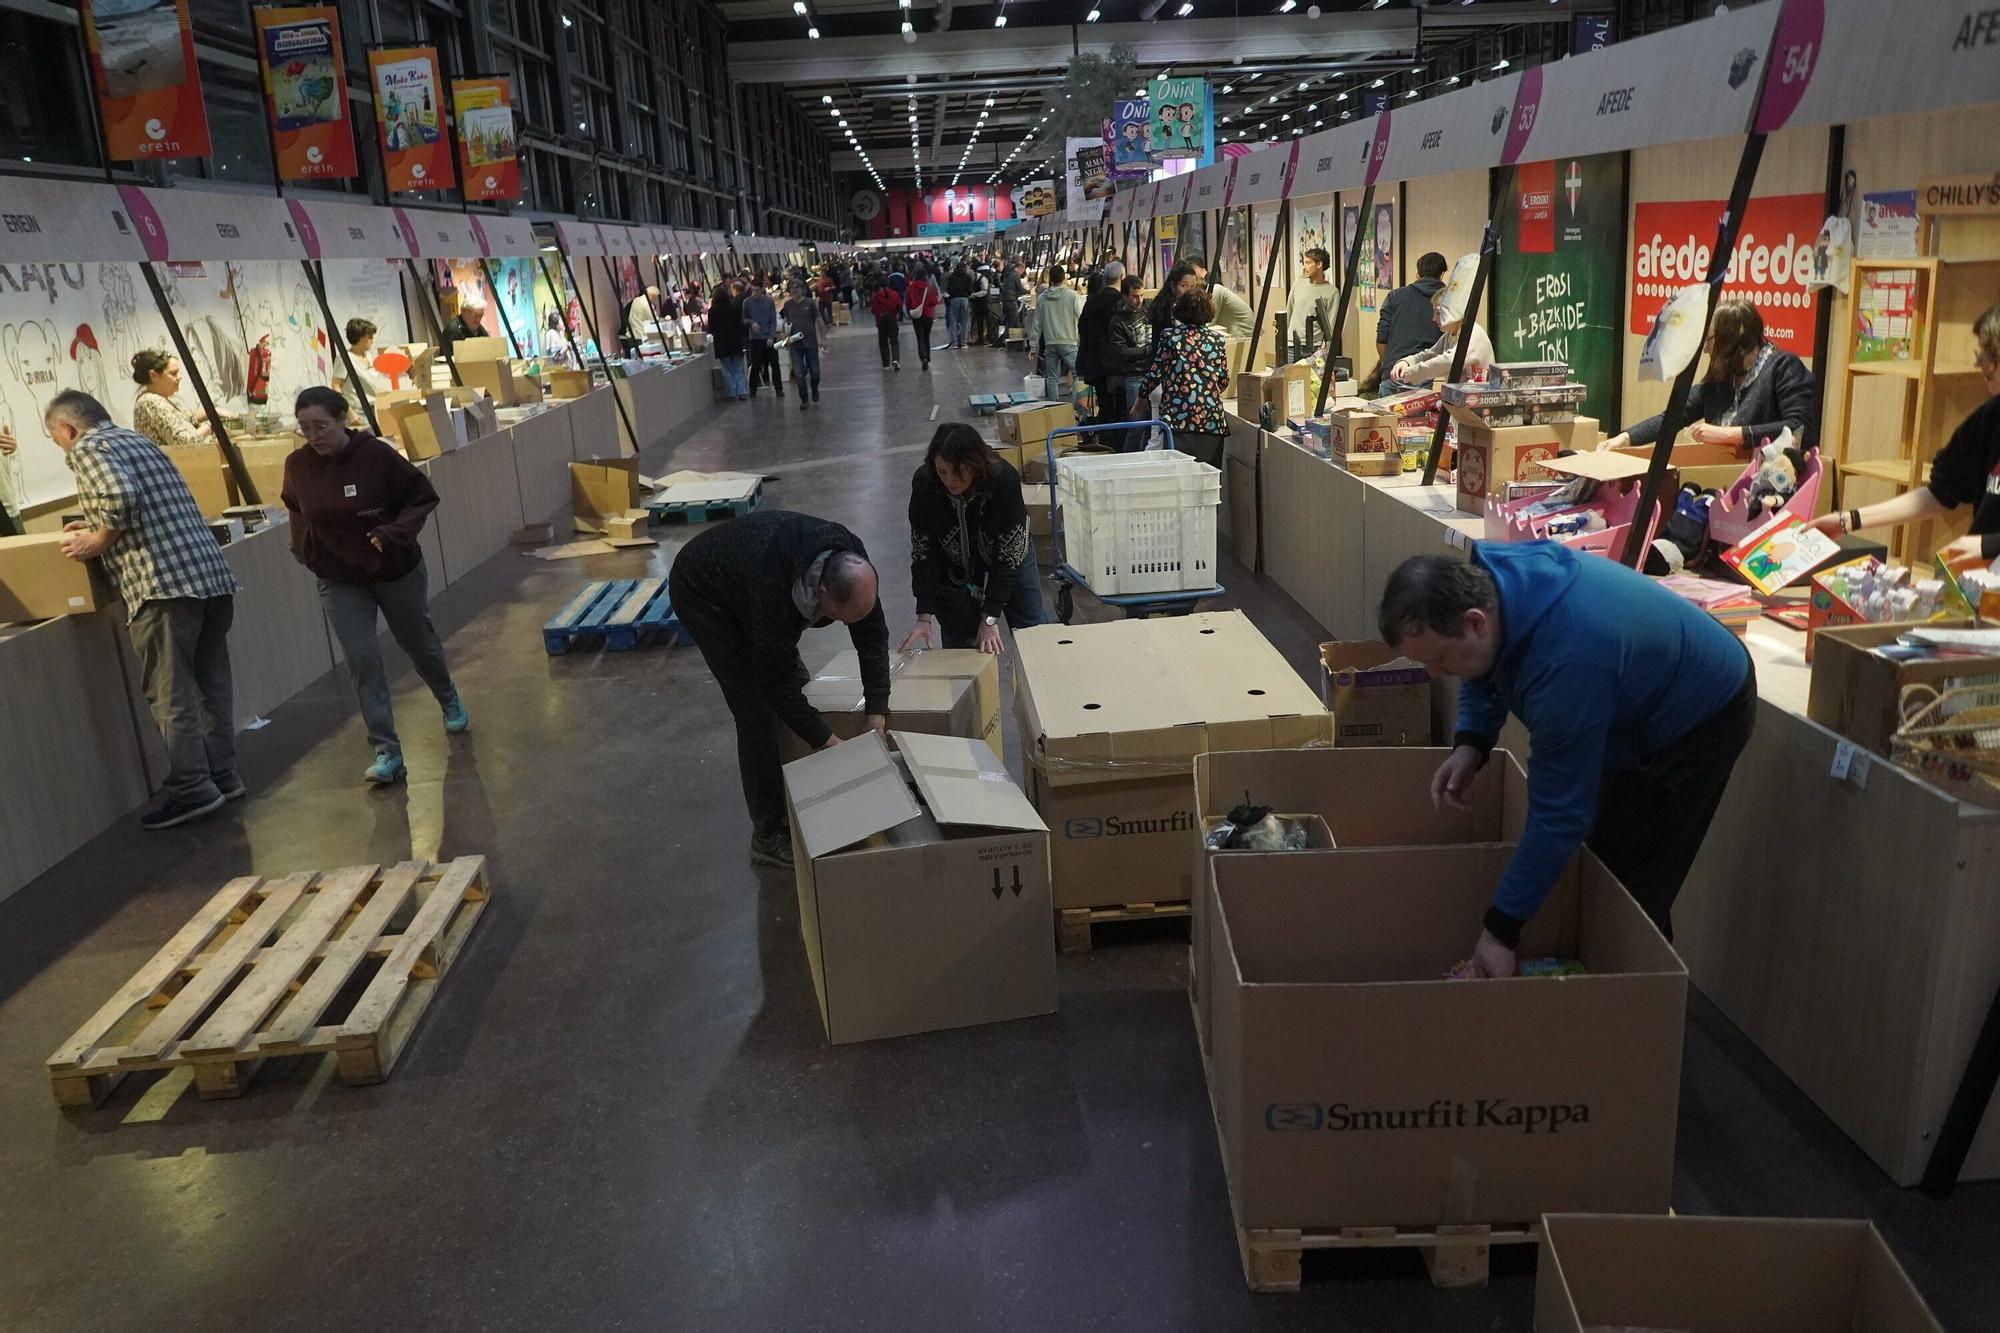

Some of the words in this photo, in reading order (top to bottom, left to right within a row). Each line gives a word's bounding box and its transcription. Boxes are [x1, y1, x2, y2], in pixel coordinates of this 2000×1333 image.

[1953, 8, 2000, 50] AFE
[1783, 43, 1812, 84] 54
[1596, 87, 1635, 116] AFEDE
[140, 141, 180, 153] erein
[1421, 130, 1443, 150] AFEDE
[301, 164, 334, 174] erein
[1085, 168, 1104, 178] NEGR
[407, 179, 434, 187] erein
[1530, 195, 1549, 205] EROSKI
[1927, 184, 2000, 206] CHILLY'S
[3, 214, 42, 233] EREIN
[216, 223, 240, 238] EREIN
[1637, 233, 1710, 281] afede
[1724, 233, 1816, 285] afede
[1536, 272, 1571, 304] EROSI
[1528, 302, 1587, 338] BAZKIDE
[1538, 336, 1568, 362] TOKI
[1550, 366, 1568, 374] 1000
[1406, 400, 1425, 411] CATAN
[1480, 397, 1498, 405] 3000
[1397, 421, 1412, 429] ATAN
[1527, 466, 1546, 474] EDUCA
[1328, 1100, 1466, 1131] Smurfit
[1475, 1100, 1590, 1134] Kappa
